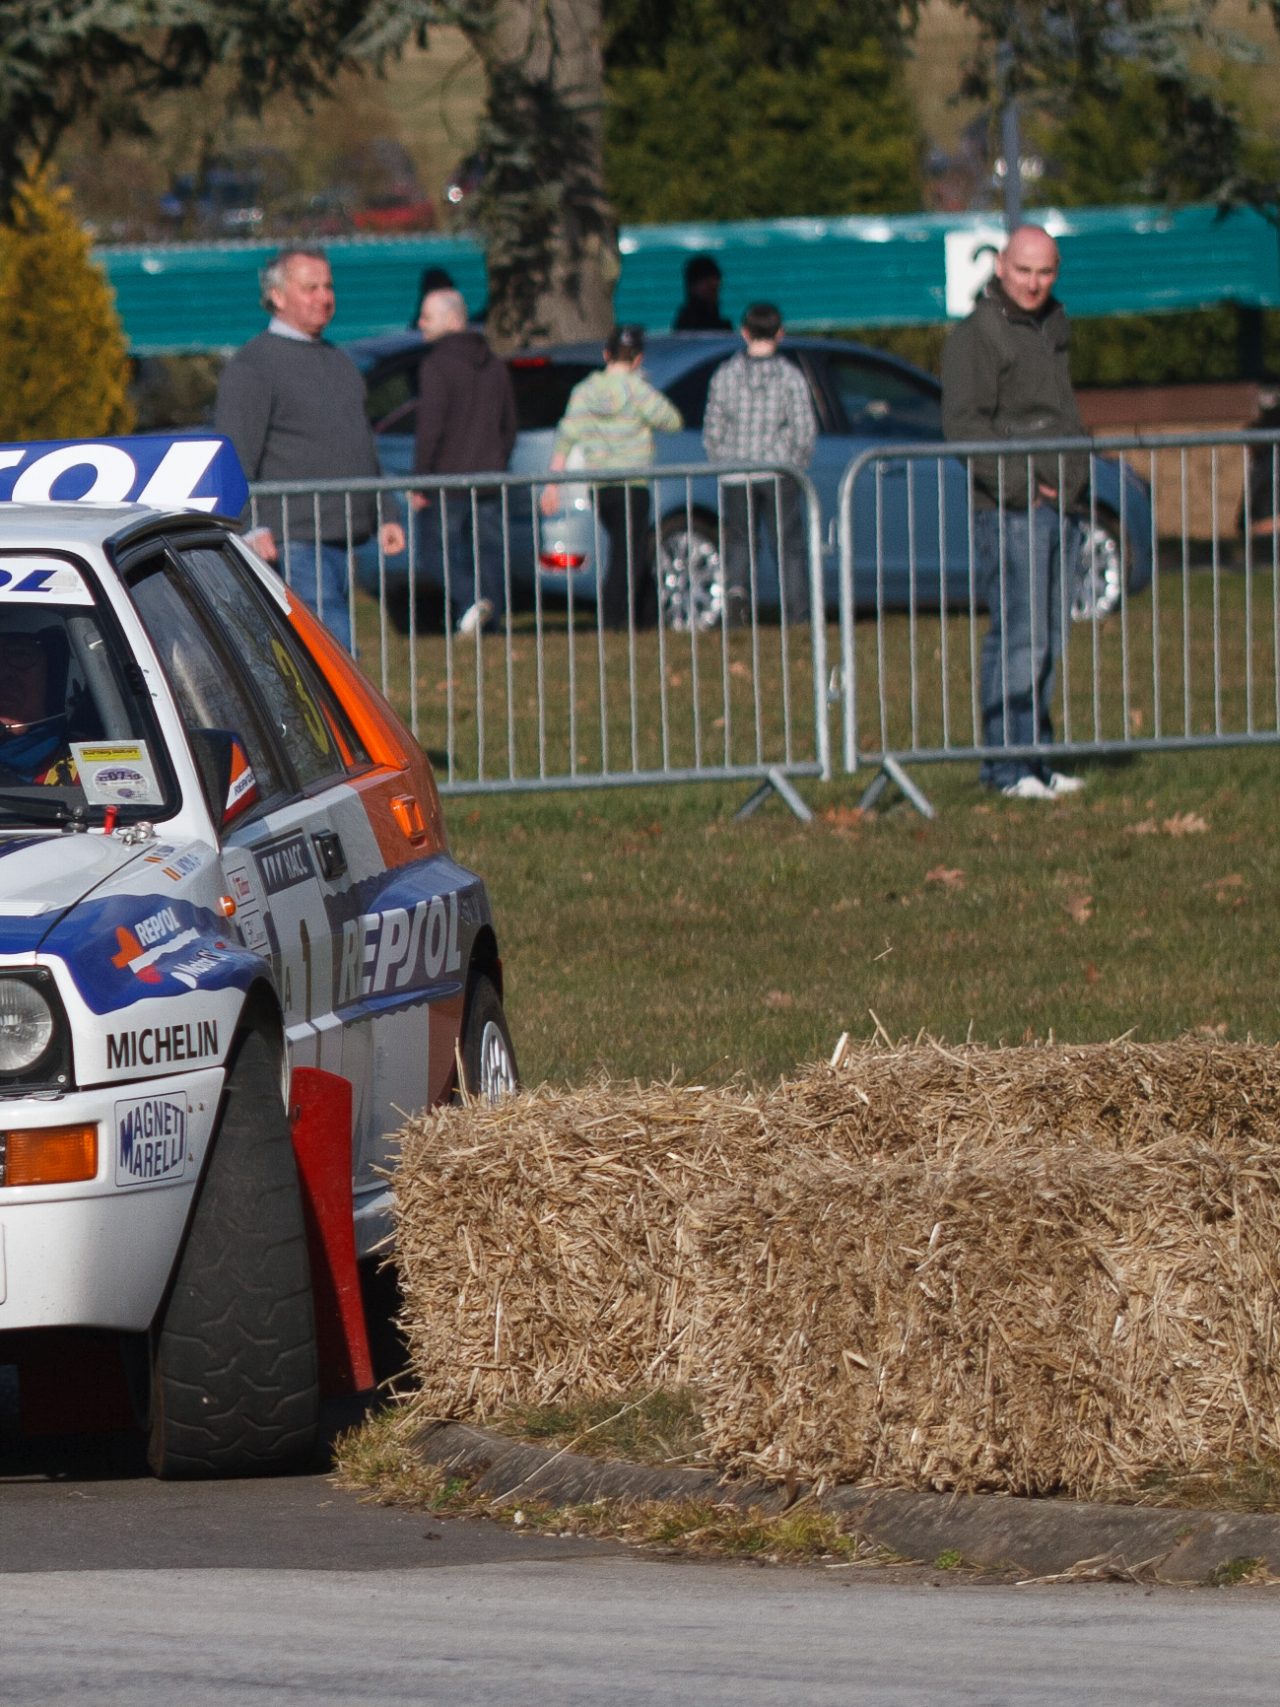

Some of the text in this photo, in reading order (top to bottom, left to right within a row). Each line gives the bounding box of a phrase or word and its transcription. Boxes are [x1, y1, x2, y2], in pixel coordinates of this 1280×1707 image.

[134, 906, 180, 947] REPSOL
[338, 890, 462, 1004] REPSOL
[106, 1019, 219, 1069] MICHELIN
